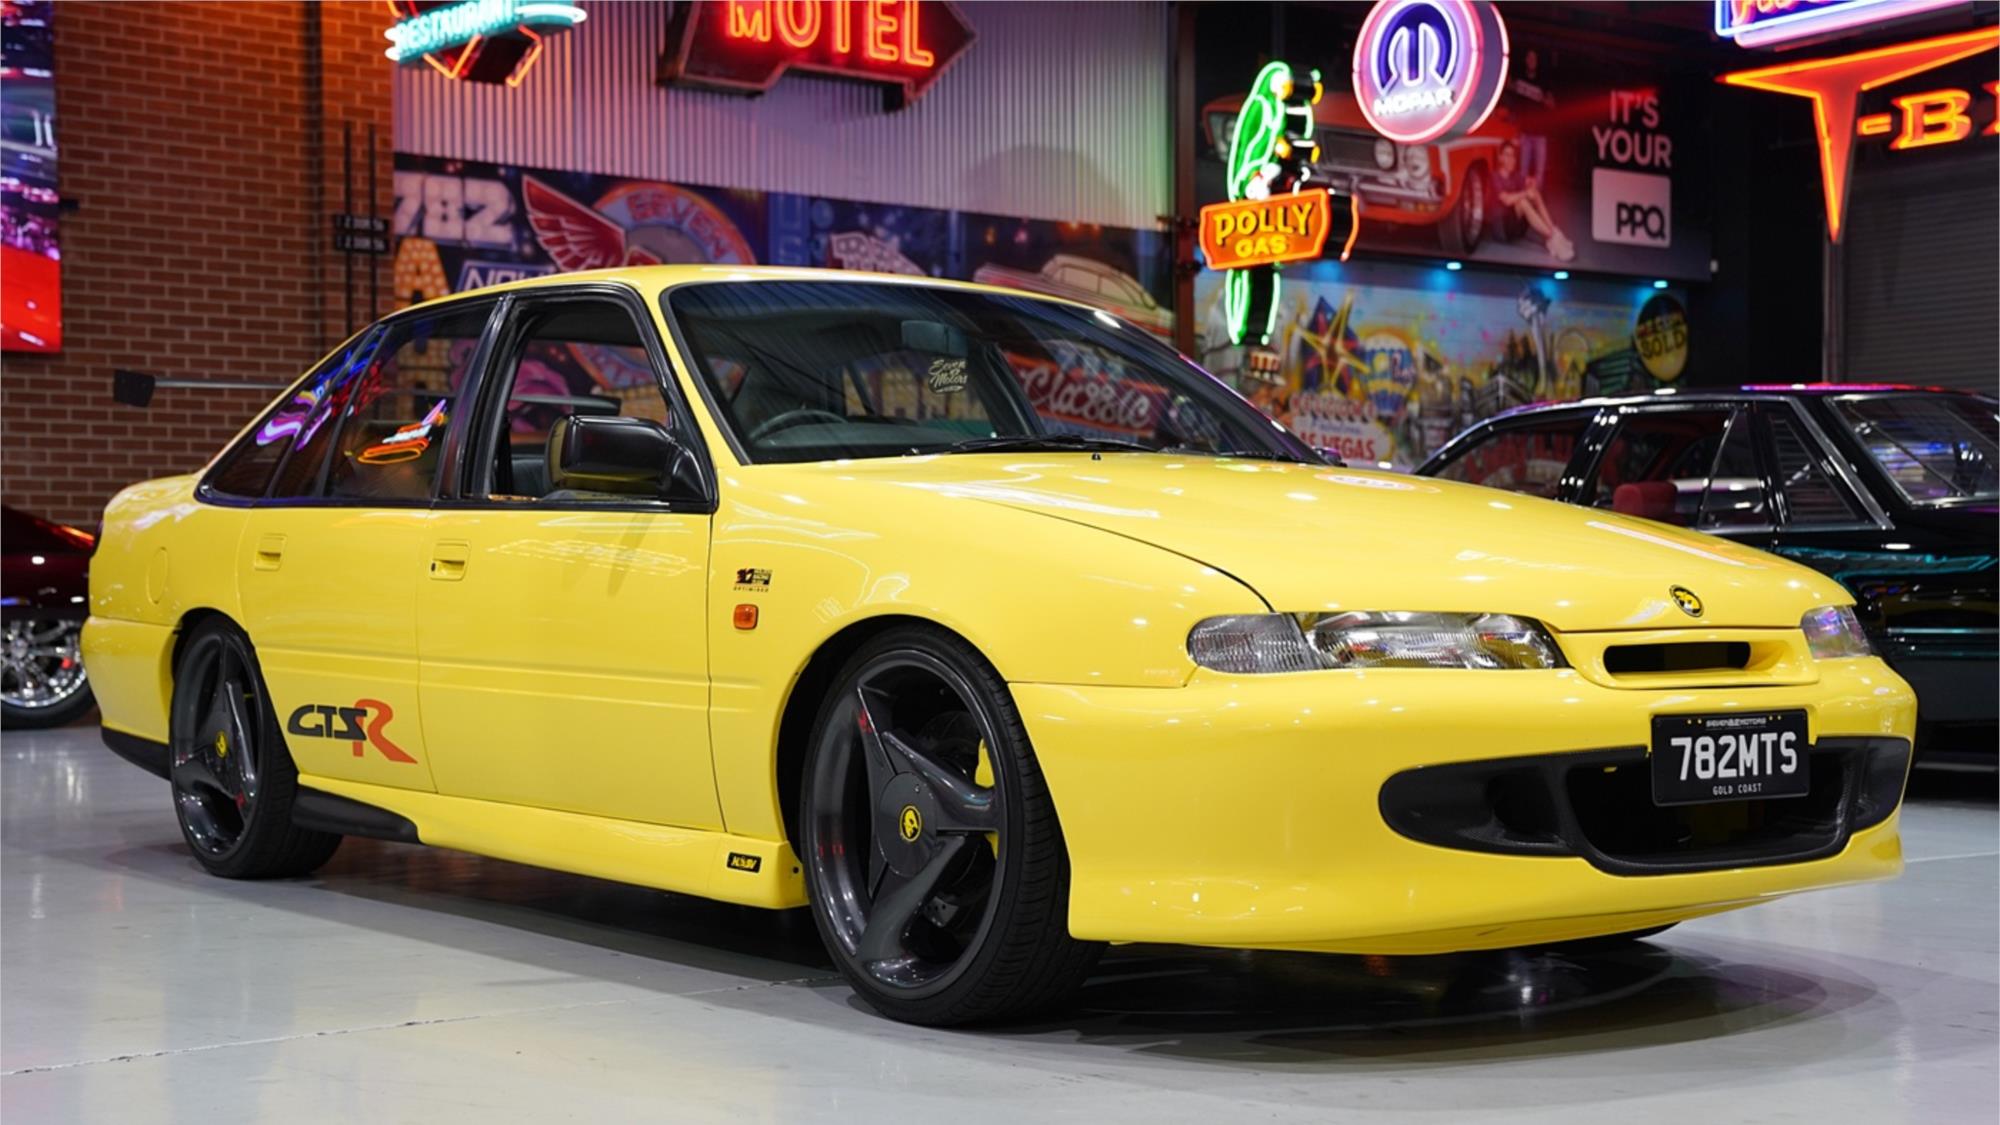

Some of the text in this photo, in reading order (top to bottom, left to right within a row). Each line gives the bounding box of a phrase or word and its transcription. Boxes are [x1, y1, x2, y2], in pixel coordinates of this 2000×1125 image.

[1610, 90, 1659, 128] IT'S
[1592, 126, 1672, 168] YOUR
[393, 171, 516, 245] 782
[1213, 202, 1314, 246] POLLY
[1616, 202, 1665, 240] PPQ
[1235, 234, 1287, 258] GAS
[1671, 731, 1798, 781] 782MTS
[1712, 782, 1763, 796] GOLD COAST
